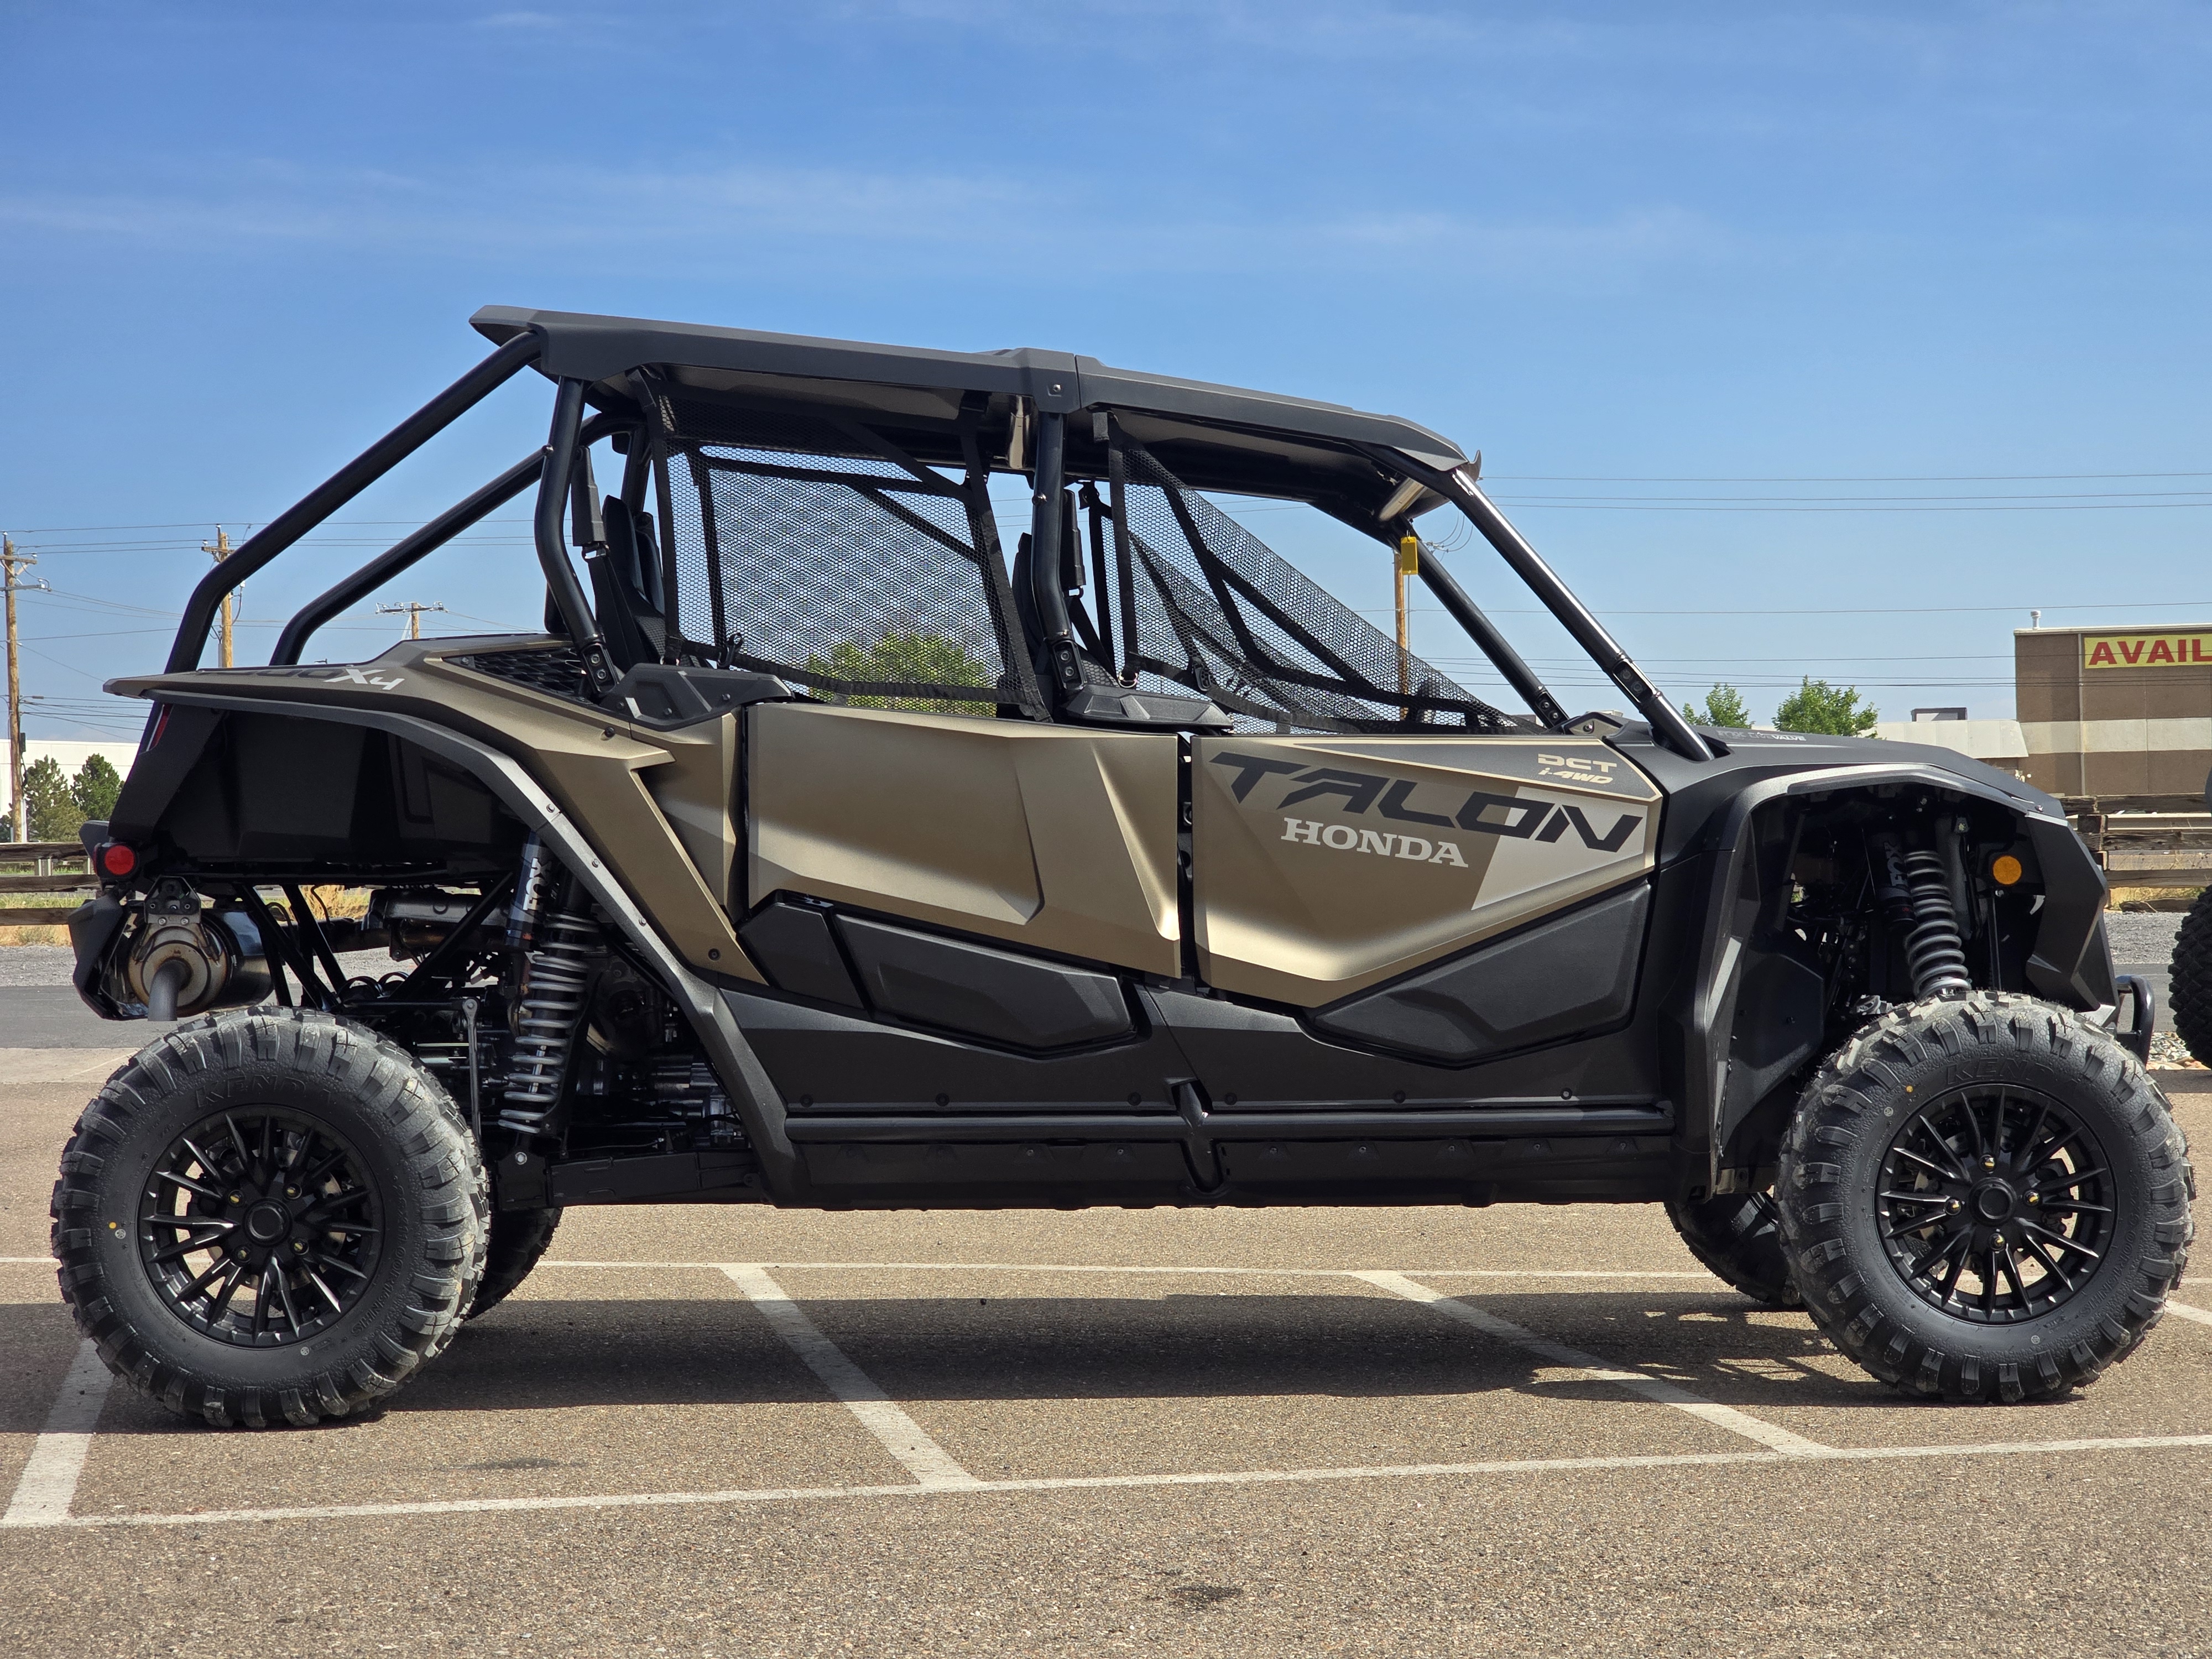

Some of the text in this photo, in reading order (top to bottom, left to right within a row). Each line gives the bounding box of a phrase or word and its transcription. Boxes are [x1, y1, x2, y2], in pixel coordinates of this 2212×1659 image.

[2088, 639, 2212, 665] AVAIL
[1538, 754, 1617, 773] DCT
[1538, 767, 1613, 784] i-4WD
[1209, 752, 1642, 853] TALON
[1280, 817, 1469, 868] HONDA
[523, 857, 552, 912] FOX
